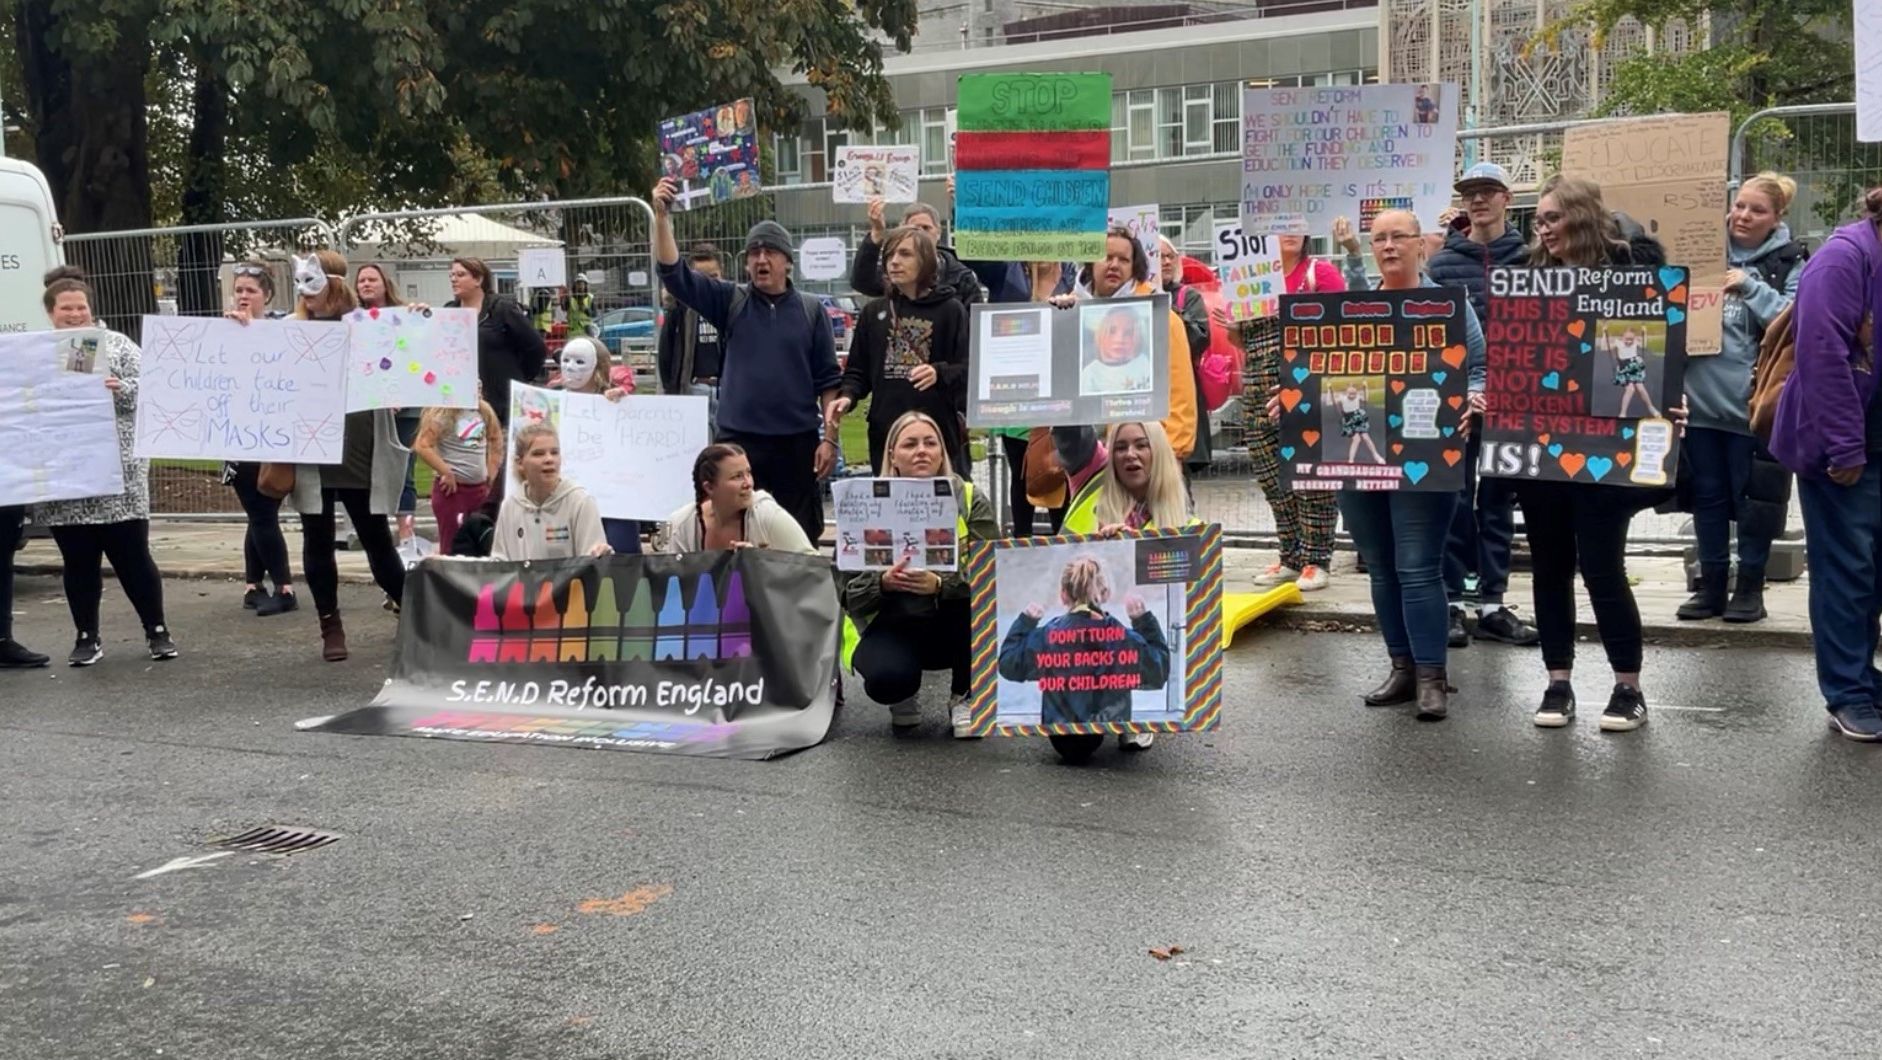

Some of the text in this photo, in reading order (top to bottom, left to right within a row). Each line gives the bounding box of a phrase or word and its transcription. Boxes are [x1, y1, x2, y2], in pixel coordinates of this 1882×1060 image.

[992, 79, 1078, 115] STOP
[1245, 113, 1266, 127] WE
[1347, 109, 1377, 124] HAVE
[1383, 110, 1399, 123] TO
[1246, 124, 1432, 144] FIGHT FOR OUR CHILDREN TO
[1245, 139, 1394, 158] GET THE FUNDING AND
[1590, 126, 1713, 168] EDUCATE
[1245, 157, 1312, 173] EDUCATION
[1318, 156, 1350, 171] THEY
[1263, 184, 1293, 199] ONLY
[1299, 184, 1332, 198] HERE
[1341, 184, 1357, 197] AS
[1366, 180, 1386, 196] IT'S
[1244, 199, 1324, 214] THING TO DO
[537, 267, 547, 280] A
[1490, 267, 1654, 296] SEND Reform
[1236, 281, 1271, 298] OUR
[1489, 298, 1569, 321] THIS IS
[1576, 295, 1664, 318] England
[1284, 323, 1446, 348] ENOUGH IS
[1488, 321, 1569, 343] DOLLY.
[195, 342, 284, 364] Let our
[1310, 351, 1427, 374] ENOUGH
[1488, 345, 1569, 370] SHE IS
[167, 368, 301, 393] Children take
[1487, 369, 1543, 391] NOT
[250, 393, 295, 416] their
[563, 391, 686, 432] Let parents
[1486, 392, 1585, 413] BROKEN!
[207, 419, 290, 451] MASKS
[1486, 412, 1617, 436] THE SYSTEM
[576, 427, 602, 445] be
[1296, 463, 1312, 475] MY
[1048, 626, 1125, 644] DON'T TURN
[1037, 650, 1138, 668] YOUR BACKS ON
[1038, 674, 1141, 692] OUR CHILDREN!
[446, 676, 764, 716] S.E.N.D Reform England
